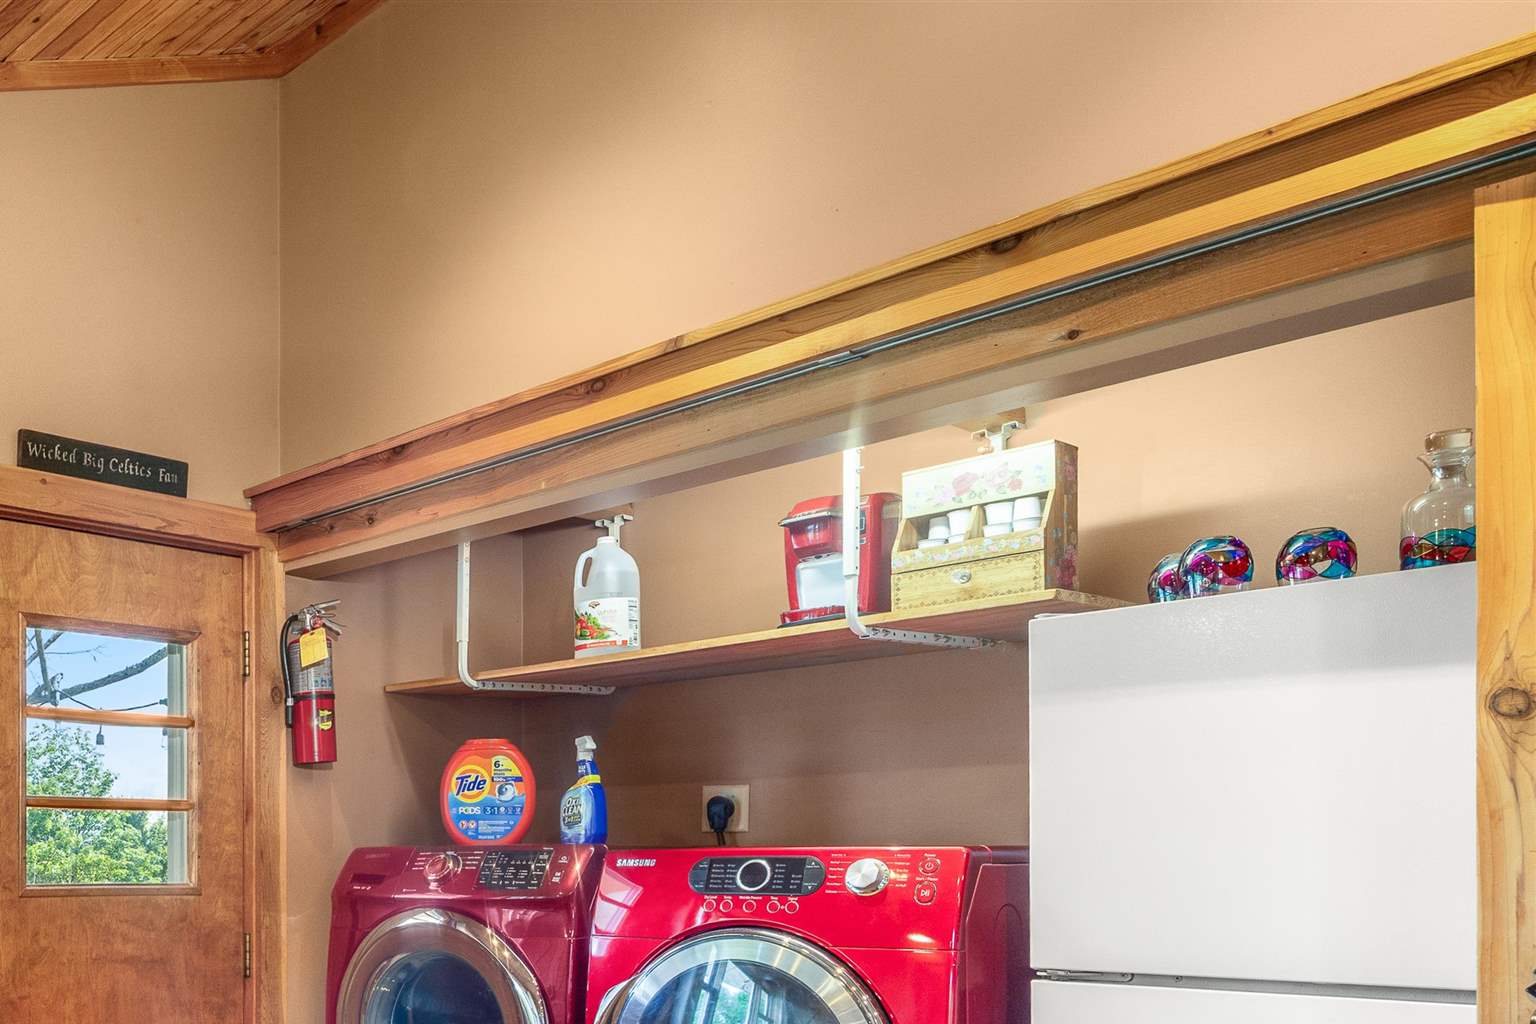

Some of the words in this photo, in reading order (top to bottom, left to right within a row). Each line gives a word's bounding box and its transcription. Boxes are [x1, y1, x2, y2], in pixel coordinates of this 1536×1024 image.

[26, 440, 78, 464] Wicked
[82, 451, 104, 474] Big
[109, 457, 152, 479] Celtics
[158, 468, 179, 485] Fan
[455, 774, 487, 797] Tide
[458, 806, 481, 815] PODS
[616, 858, 657, 867] SAMSUNG
